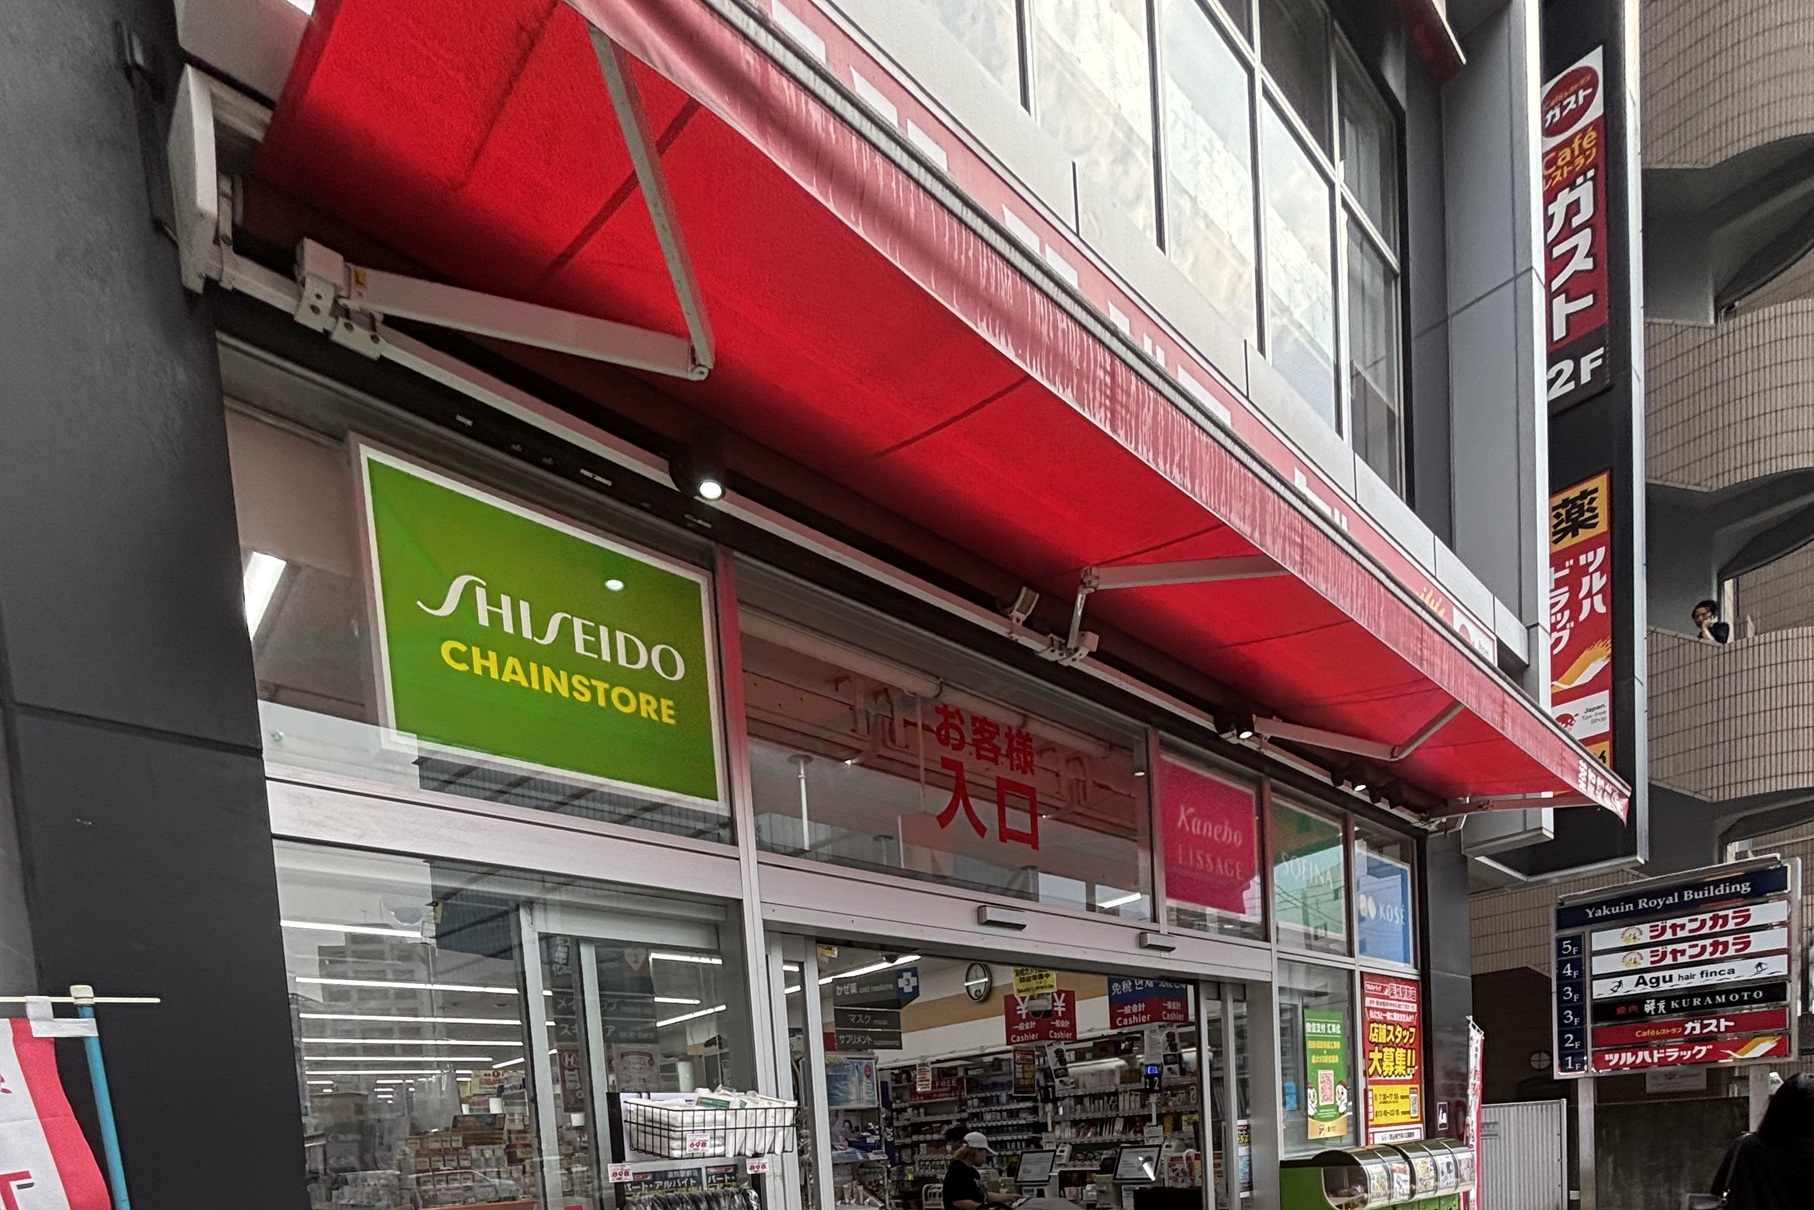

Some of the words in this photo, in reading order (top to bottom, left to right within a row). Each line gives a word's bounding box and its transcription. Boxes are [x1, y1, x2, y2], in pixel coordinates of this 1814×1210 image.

[1544, 88, 1593, 128] ガスト
[1543, 125, 1597, 174] Café
[1543, 146, 1597, 191] レストラン
[1547, 168, 1596, 341] ガスト
[1547, 347, 1605, 401] 2F
[1551, 486, 1599, 545] 薬
[1579, 546, 1607, 622] ツルハ
[1550, 557, 1574, 654] ドラッグ
[417, 574, 686, 682] SHISEIDO
[440, 639, 677, 726] CHAINSTORE
[934, 703, 1036, 777] お客様
[936, 755, 1040, 851] 入口
[1177, 804, 1242, 848] Kanebo
[1178, 844, 1245, 881] LISSAGE
[1281, 852, 1333, 889] SOFINA
[1379, 903, 1405, 925] KOSÉ
[1585, 898, 1634, 919] Yakuin
[1638, 893, 1680, 910] Royal
[1683, 881, 1752, 901] Building
[1562, 940, 1578, 955] 5F
[1649, 908, 1752, 940] ジャンカラ
[1562, 963, 1579, 978] 4F
[1650, 935, 1752, 965] ジャンカラ
[1563, 986, 1580, 1002] 3F
[1634, 974, 1674, 989] Agu
[1678, 972, 1696, 982] hair
[1700, 966, 1736, 979] finca
[1116, 1013, 1151, 1026] Cashier
[1162, 1011, 1185, 1020] Cashier
[1563, 1010, 1580, 1026] 3F
[1670, 990, 1764, 1010] KURAMOTO
[1010, 1033, 1039, 1043] Cashier
[1048, 1030, 1073, 1039] Cashier
[1368, 1022, 1416, 1045] 店舗スタッフ
[1564, 1033, 1580, 1049] 2F
[1684, 1018, 1736, 1036] ガスト
[1565, 1056, 1581, 1071] 1F
[1604, 1044, 1713, 1067] ツルハドラッグ
[612, 1170, 629, 1178] 898
